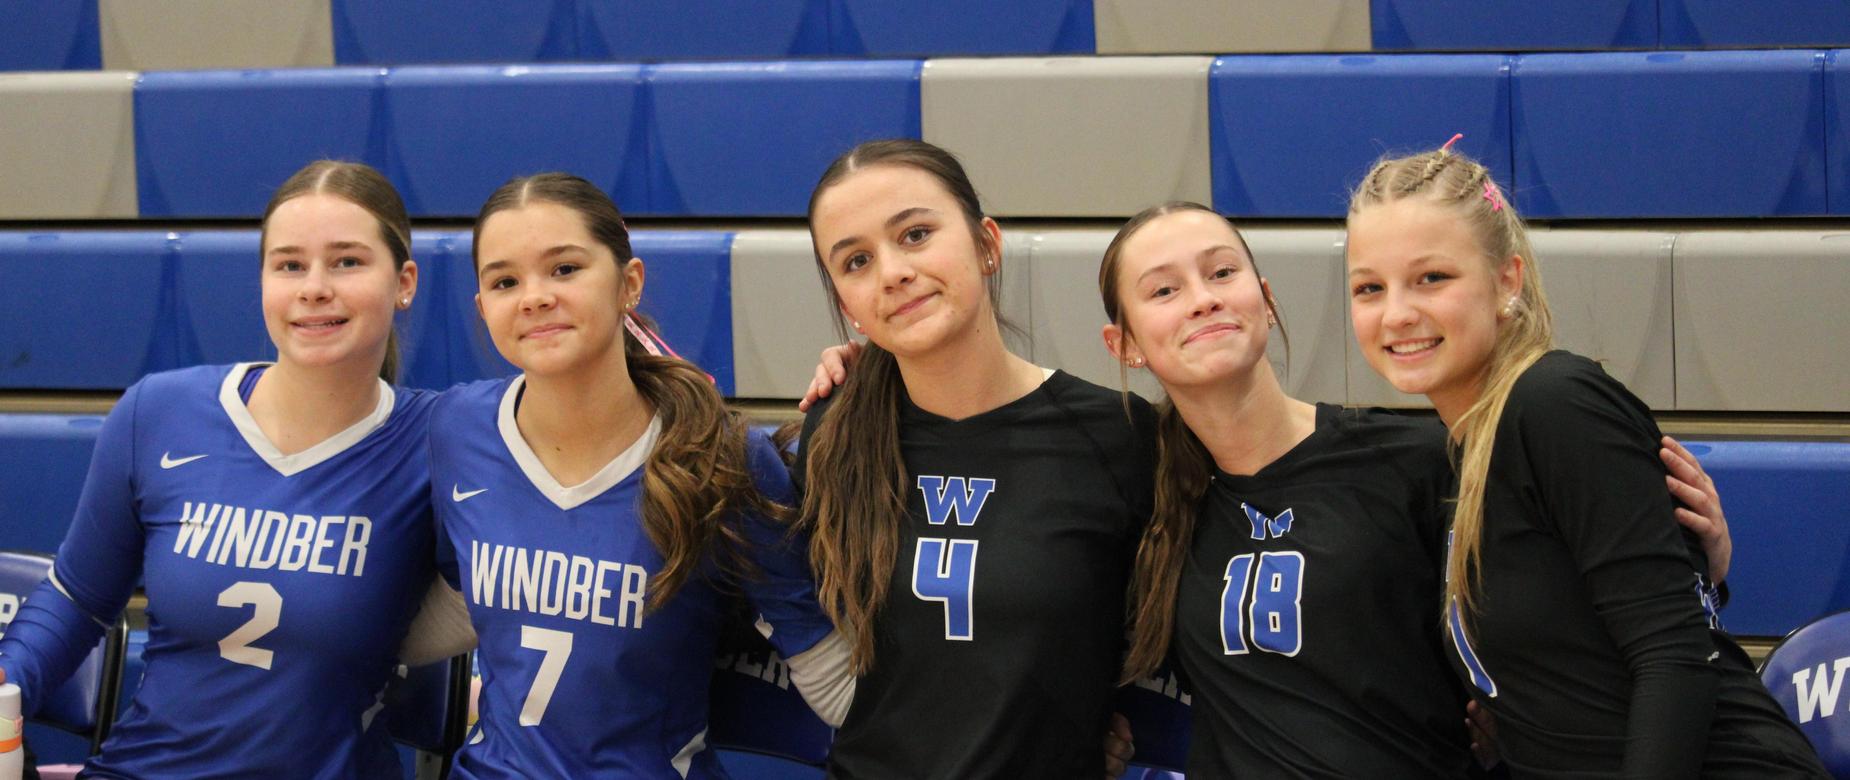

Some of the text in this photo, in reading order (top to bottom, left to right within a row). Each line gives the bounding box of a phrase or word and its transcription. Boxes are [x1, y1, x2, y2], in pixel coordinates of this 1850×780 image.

[173, 502, 372, 577] WINDBER
[917, 475, 996, 526] W
[217, 581, 283, 671] 2
[472, 540, 648, 629] WINDBER
[911, 537, 979, 641] 4
[1220, 551, 1305, 658] 18
[519, 625, 574, 727] 7
[1792, 656, 1850, 724] W
